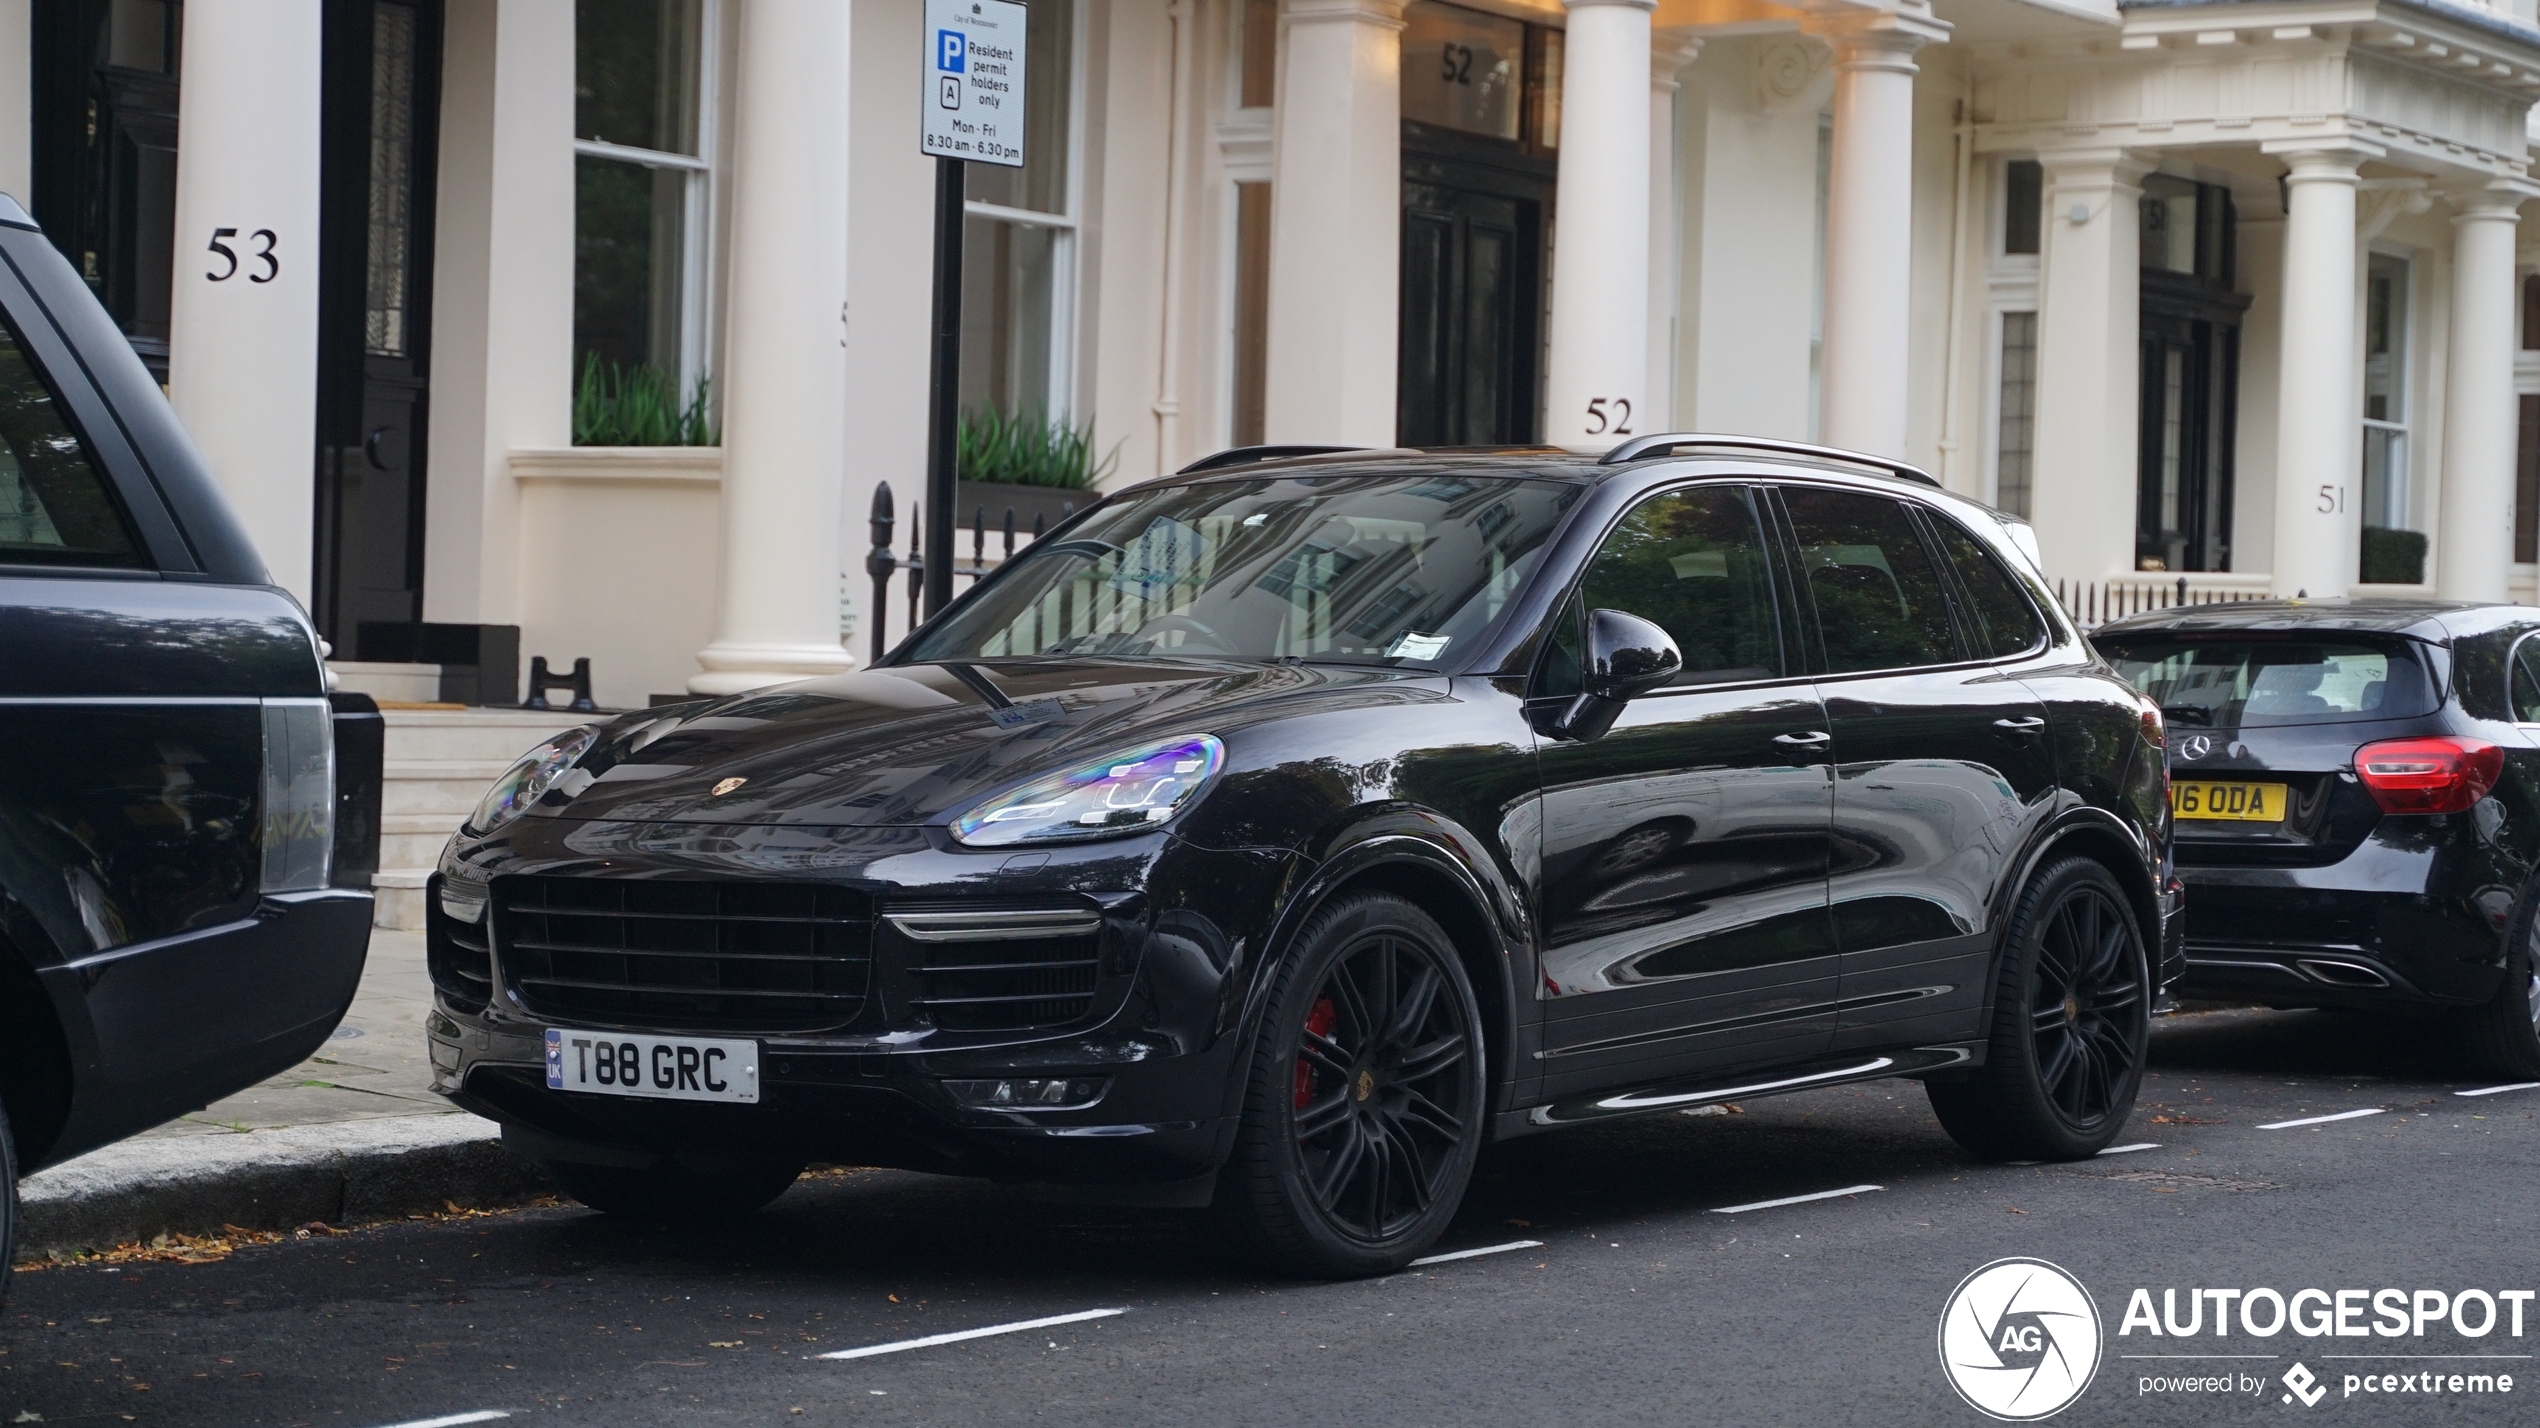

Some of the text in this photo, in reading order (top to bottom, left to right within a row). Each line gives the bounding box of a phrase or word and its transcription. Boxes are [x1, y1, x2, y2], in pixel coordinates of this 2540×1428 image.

[970, 17, 998, 29] Westminster
[944, 35, 962, 68] P
[969, 42, 1013, 61] Resident
[974, 61, 1008, 76] permit
[1442, 42, 1472, 84] 52
[946, 85, 955, 100] A
[971, 75, 1009, 92] holders
[979, 94, 1001, 109] only
[952, 119, 974, 134] Mon
[982, 124, 996, 137] Fri
[927, 134, 952, 149] 8.30
[954, 141, 970, 152] am
[977, 141, 1002, 156] 6.30
[1004, 147, 1019, 159] pm
[206, 228, 279, 284] 53
[1585, 398, 1632, 435] 52
[2317, 485, 2344, 514] 51
[2171, 785, 2264, 814] 16 ODA
[548, 1063, 562, 1080] UK
[572, 1038, 728, 1093] T88 GRC
